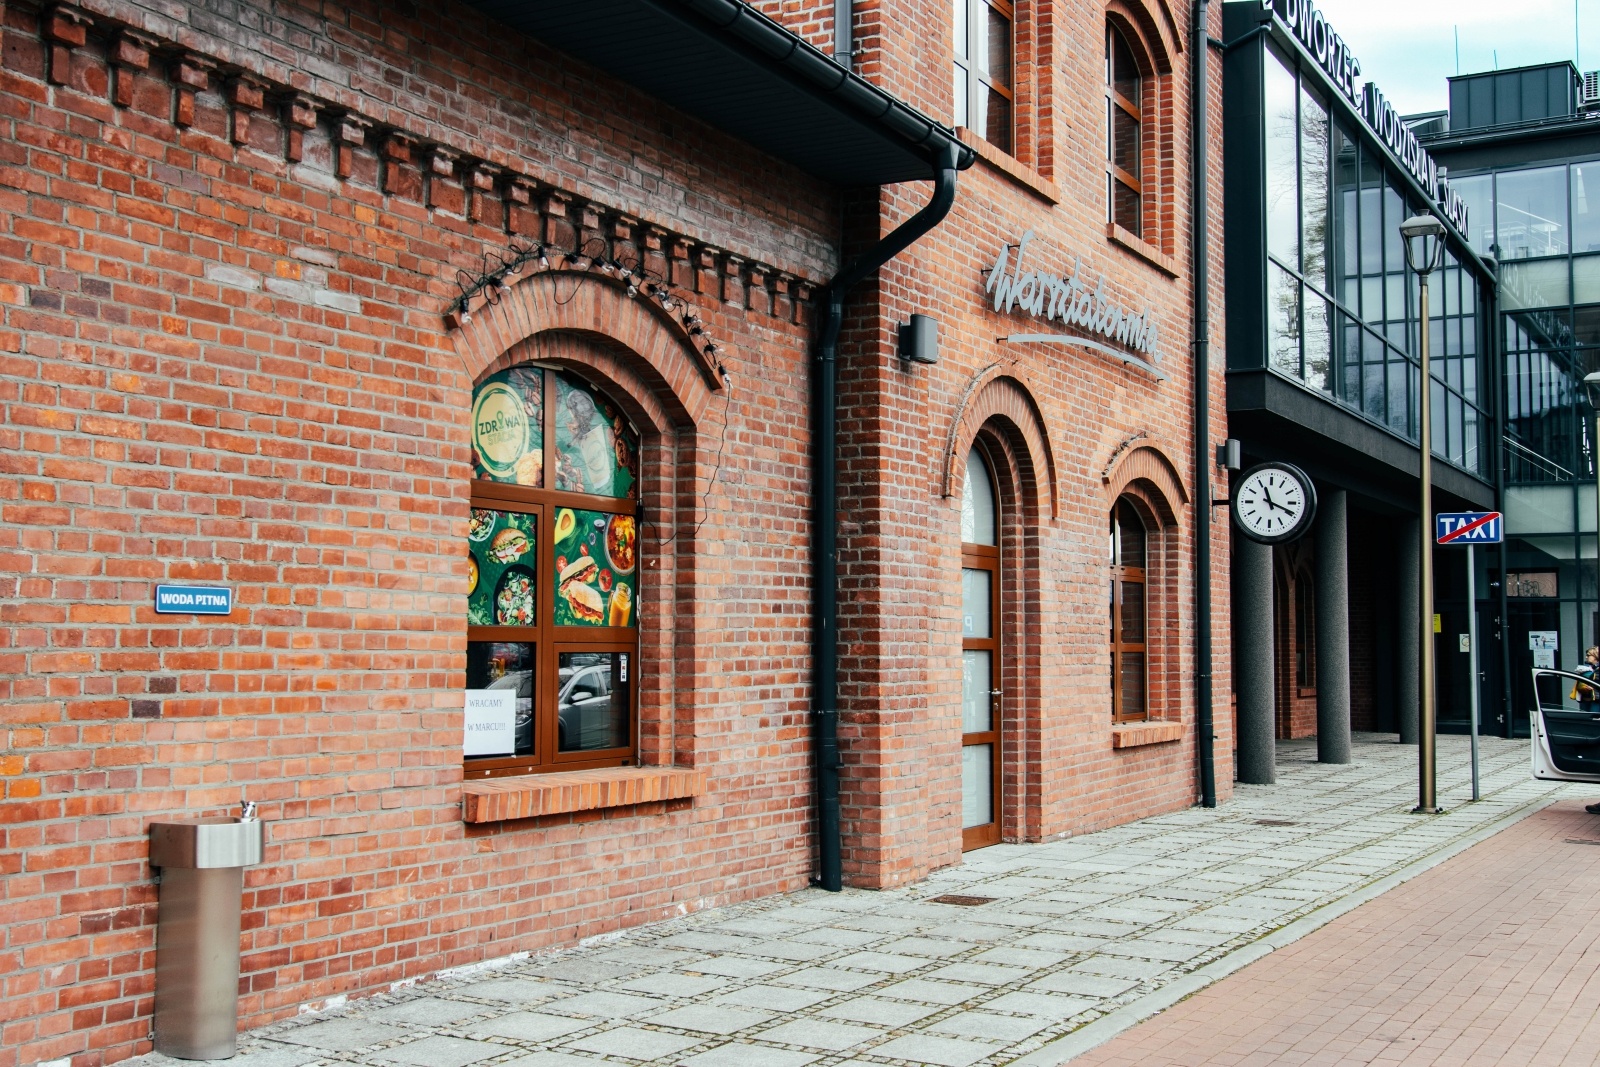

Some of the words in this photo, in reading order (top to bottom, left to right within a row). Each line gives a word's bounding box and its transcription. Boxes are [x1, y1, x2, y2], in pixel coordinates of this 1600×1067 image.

[1440, 517, 1495, 539] TAXI
[161, 593, 194, 605] WODA
[195, 594, 228, 606] PITNA
[469, 699, 503, 707] WRACAMY
[467, 723, 474, 731] W
[475, 722, 506, 731] MARCU!!!
